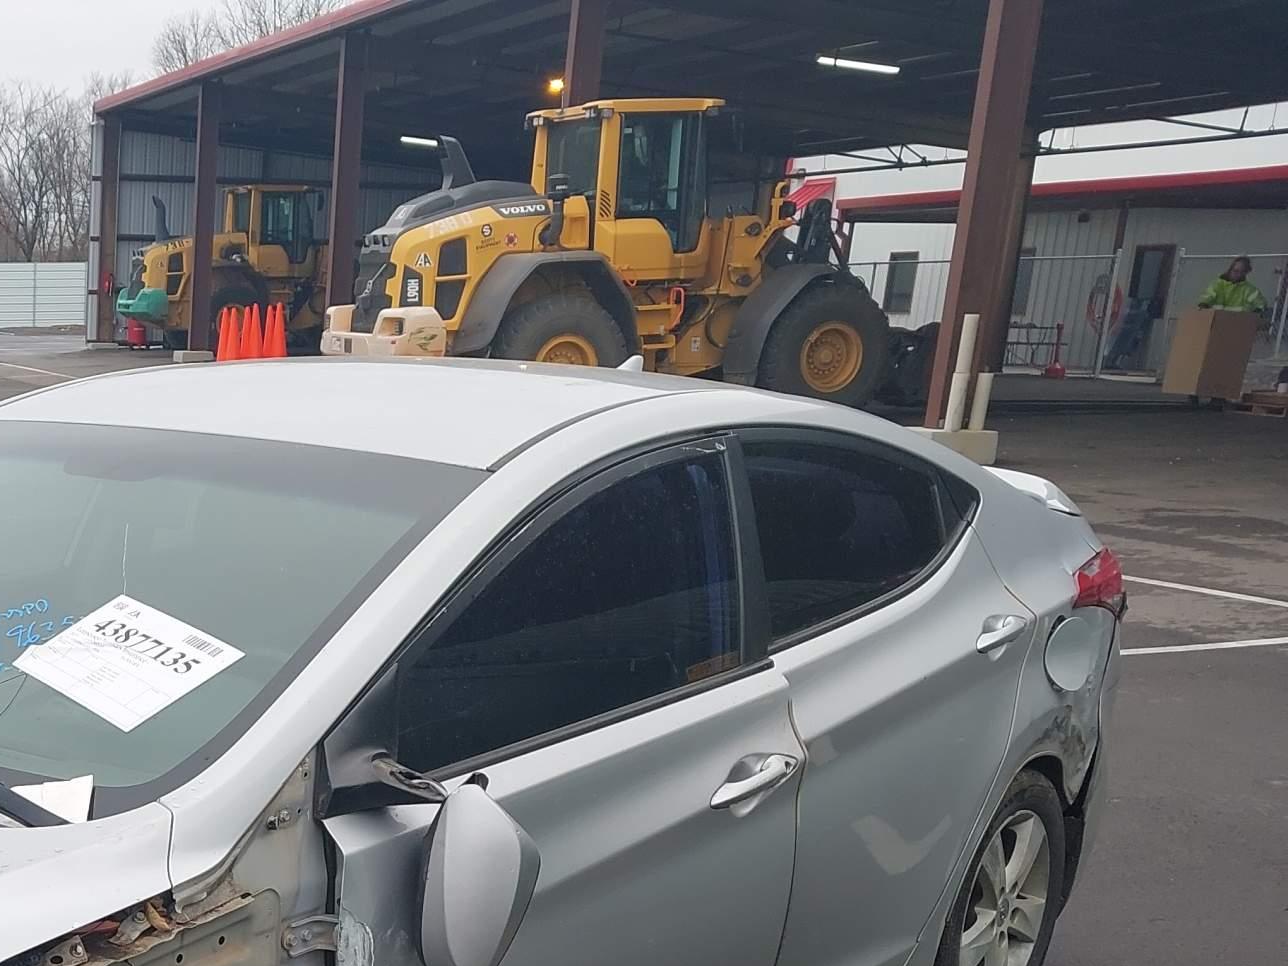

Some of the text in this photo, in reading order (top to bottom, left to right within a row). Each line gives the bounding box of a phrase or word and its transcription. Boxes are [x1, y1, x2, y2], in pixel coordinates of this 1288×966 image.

[499, 204, 546, 215] VOLVO
[407, 278, 419, 302] L90H
[93, 620, 202, 674] 43877135
